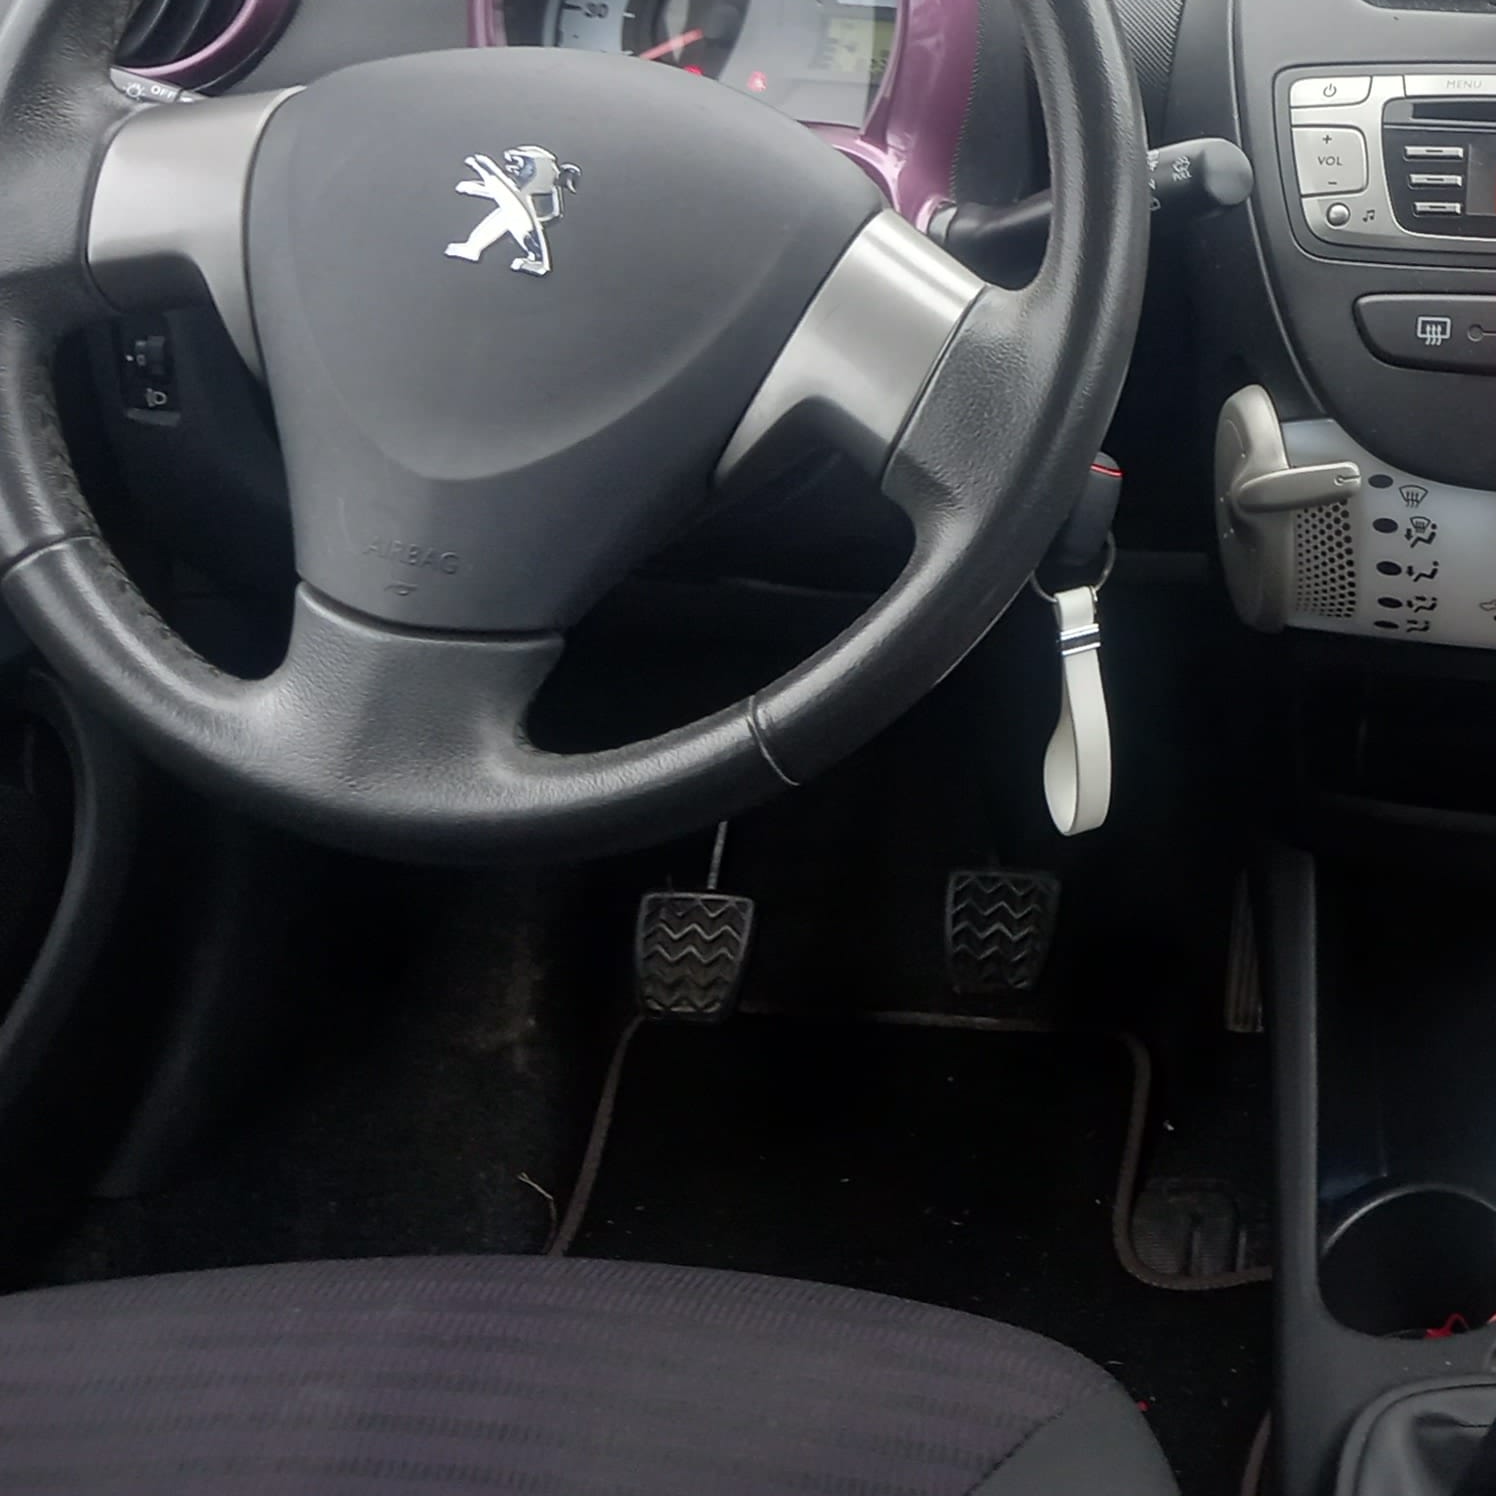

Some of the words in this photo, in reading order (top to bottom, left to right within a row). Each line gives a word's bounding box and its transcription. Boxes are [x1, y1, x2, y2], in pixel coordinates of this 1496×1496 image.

[1445, 79, 1482, 90] MENU
[151, 87, 177, 99] OFF
[1318, 156, 1343, 166] VOL
